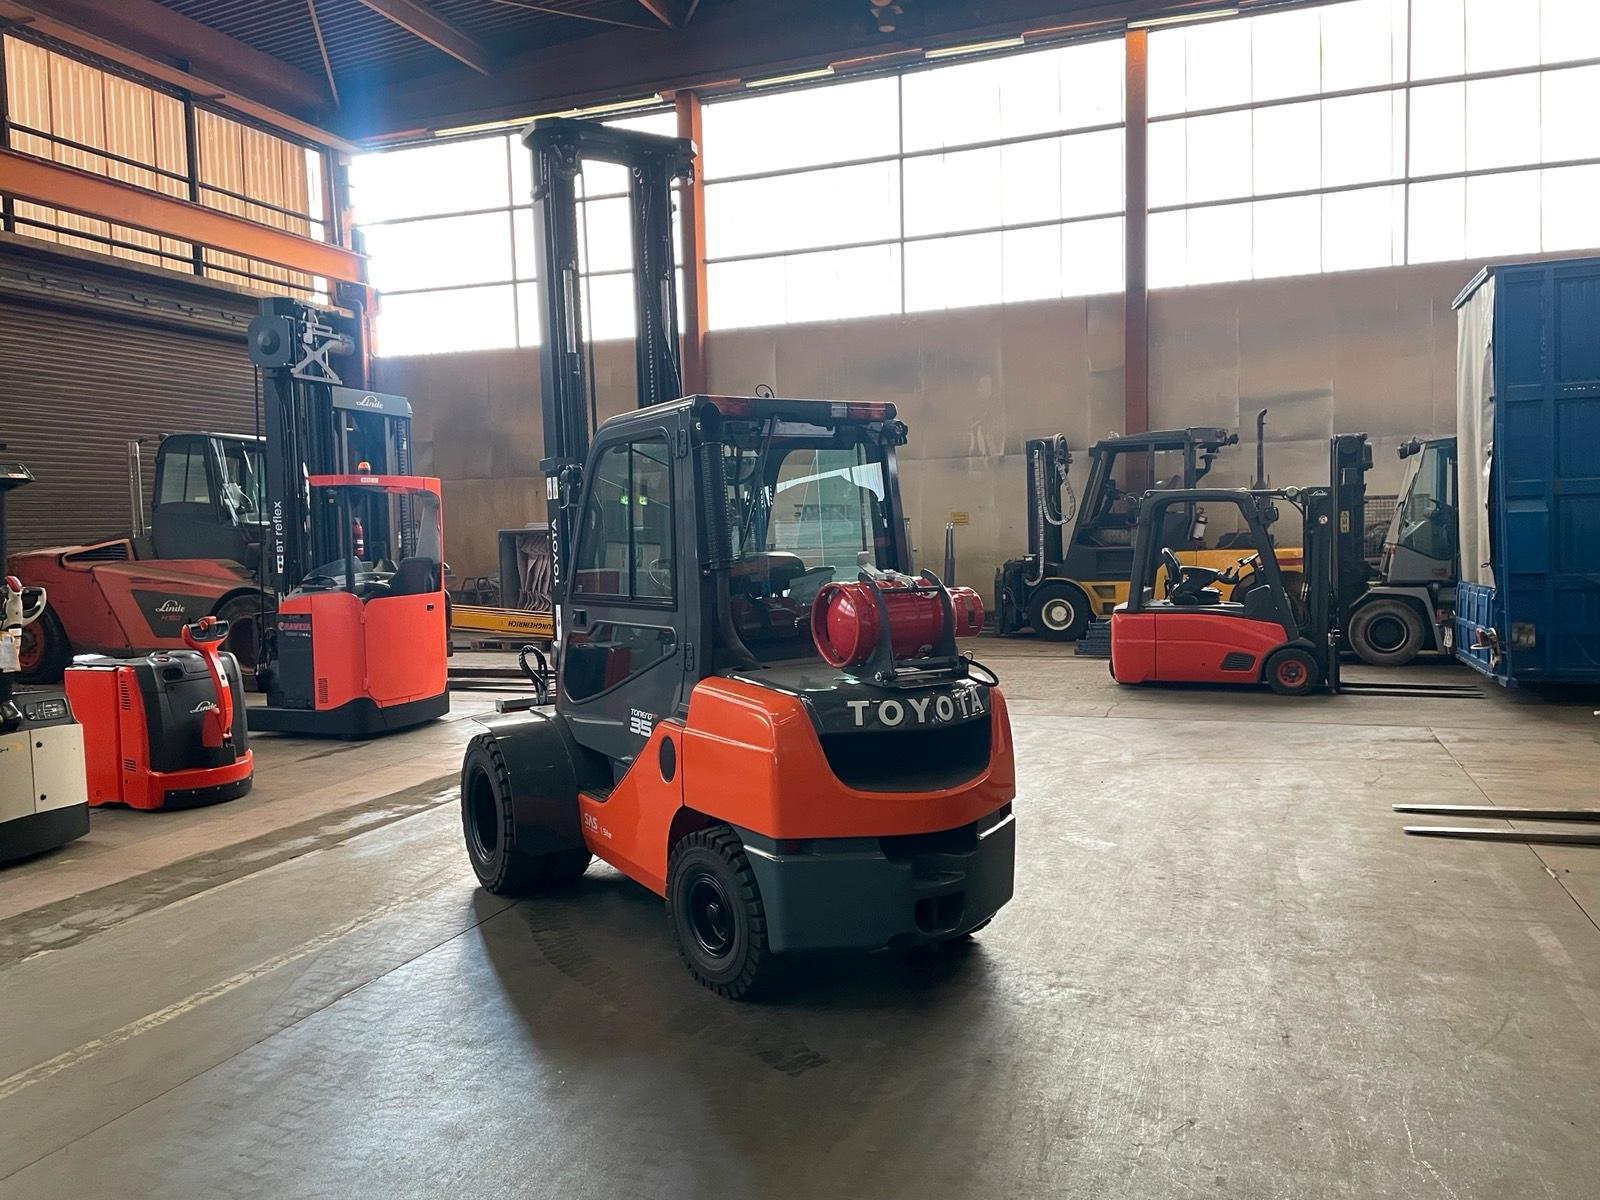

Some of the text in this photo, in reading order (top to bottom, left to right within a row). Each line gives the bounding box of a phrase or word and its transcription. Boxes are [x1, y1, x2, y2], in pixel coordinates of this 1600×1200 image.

[356, 395, 384, 408] Linde
[273, 501, 284, 553] BT reflex
[551, 518, 560, 586] TOYOTA
[155, 599, 185, 612] Linde
[847, 685, 986, 727] TOYOTA
[629, 716, 652, 737] 35
[584, 812, 598, 830] SAS
